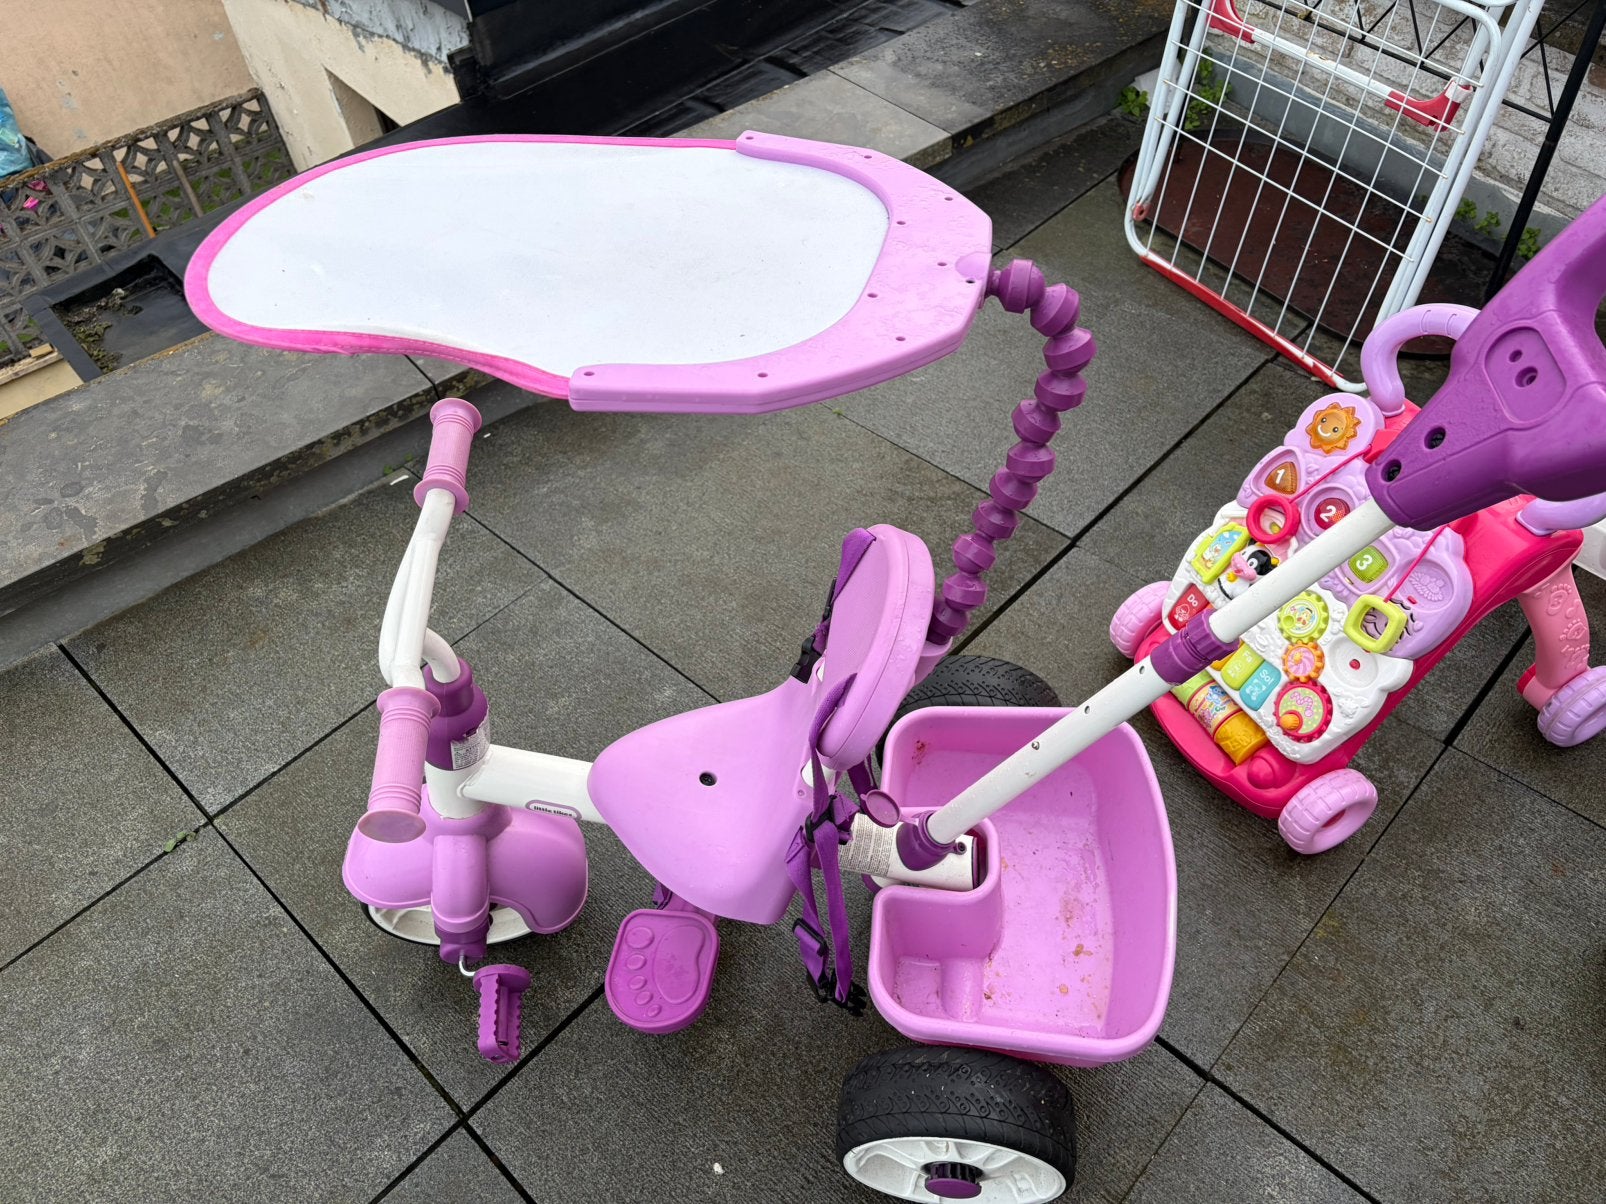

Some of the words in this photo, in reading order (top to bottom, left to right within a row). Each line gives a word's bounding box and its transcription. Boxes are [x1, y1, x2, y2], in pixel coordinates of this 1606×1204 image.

[1275, 469, 1285, 484] 1
[1320, 505, 1336, 522] 2
[1356, 554, 1373, 571] 3
[1187, 594, 1199, 607] Do
[1259, 669, 1275, 685] Sol
